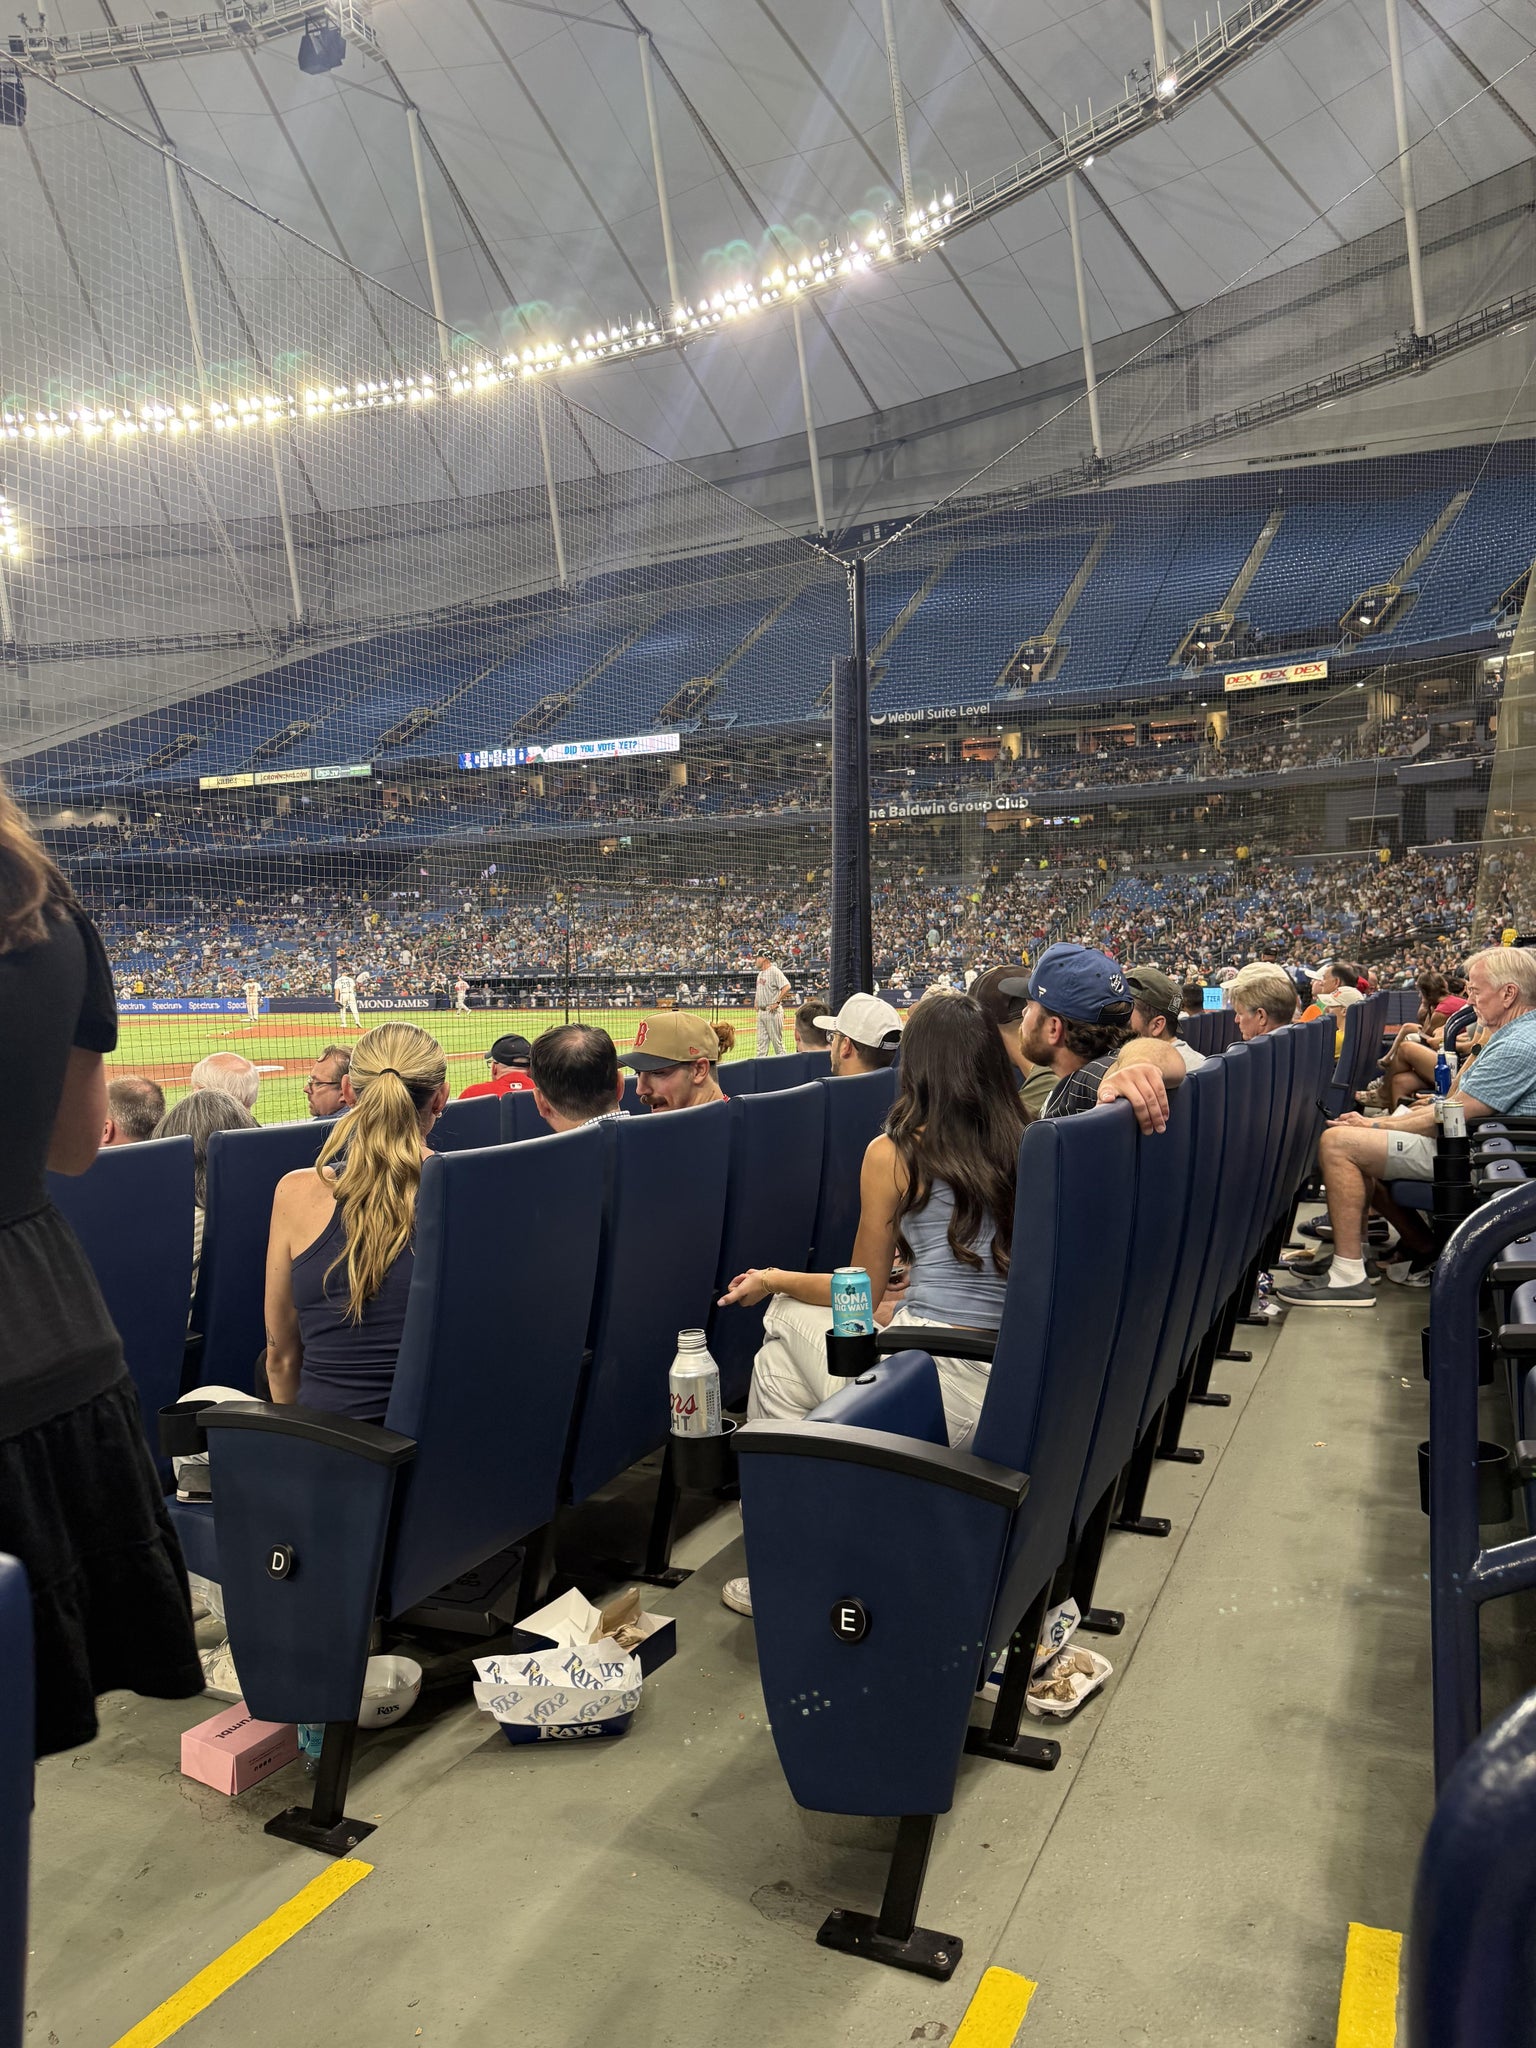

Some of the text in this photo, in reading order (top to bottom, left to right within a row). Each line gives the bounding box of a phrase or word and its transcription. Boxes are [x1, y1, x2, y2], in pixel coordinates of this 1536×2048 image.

[1260, 669, 1288, 680] DEX
[1294, 664, 1323, 675] DEX
[1226, 674, 1254, 685] DEX
[888, 702, 990, 723] Webull Suite Level
[564, 740, 638, 755] DID YOU VOTE YET?
[888, 802, 946, 817] Baldwin
[948, 800, 993, 814] Group
[995, 796, 1029, 810] Club
[116, 1002, 143, 1010] Spectrum
[152, 1002, 179, 1011] Spectrum
[188, 1001, 217, 1010] Spectrum
[394, 998, 429, 1008] JAMES
[635, 1022, 649, 1047] B
[834, 1291, 868, 1305] KONA
[834, 1302, 869, 1312] BIG WAVE
[272, 1551, 284, 1571] D
[841, 1608, 856, 1632] E
[376, 1704, 400, 1715] RAYS
[537, 1724, 602, 1740] RAYS
